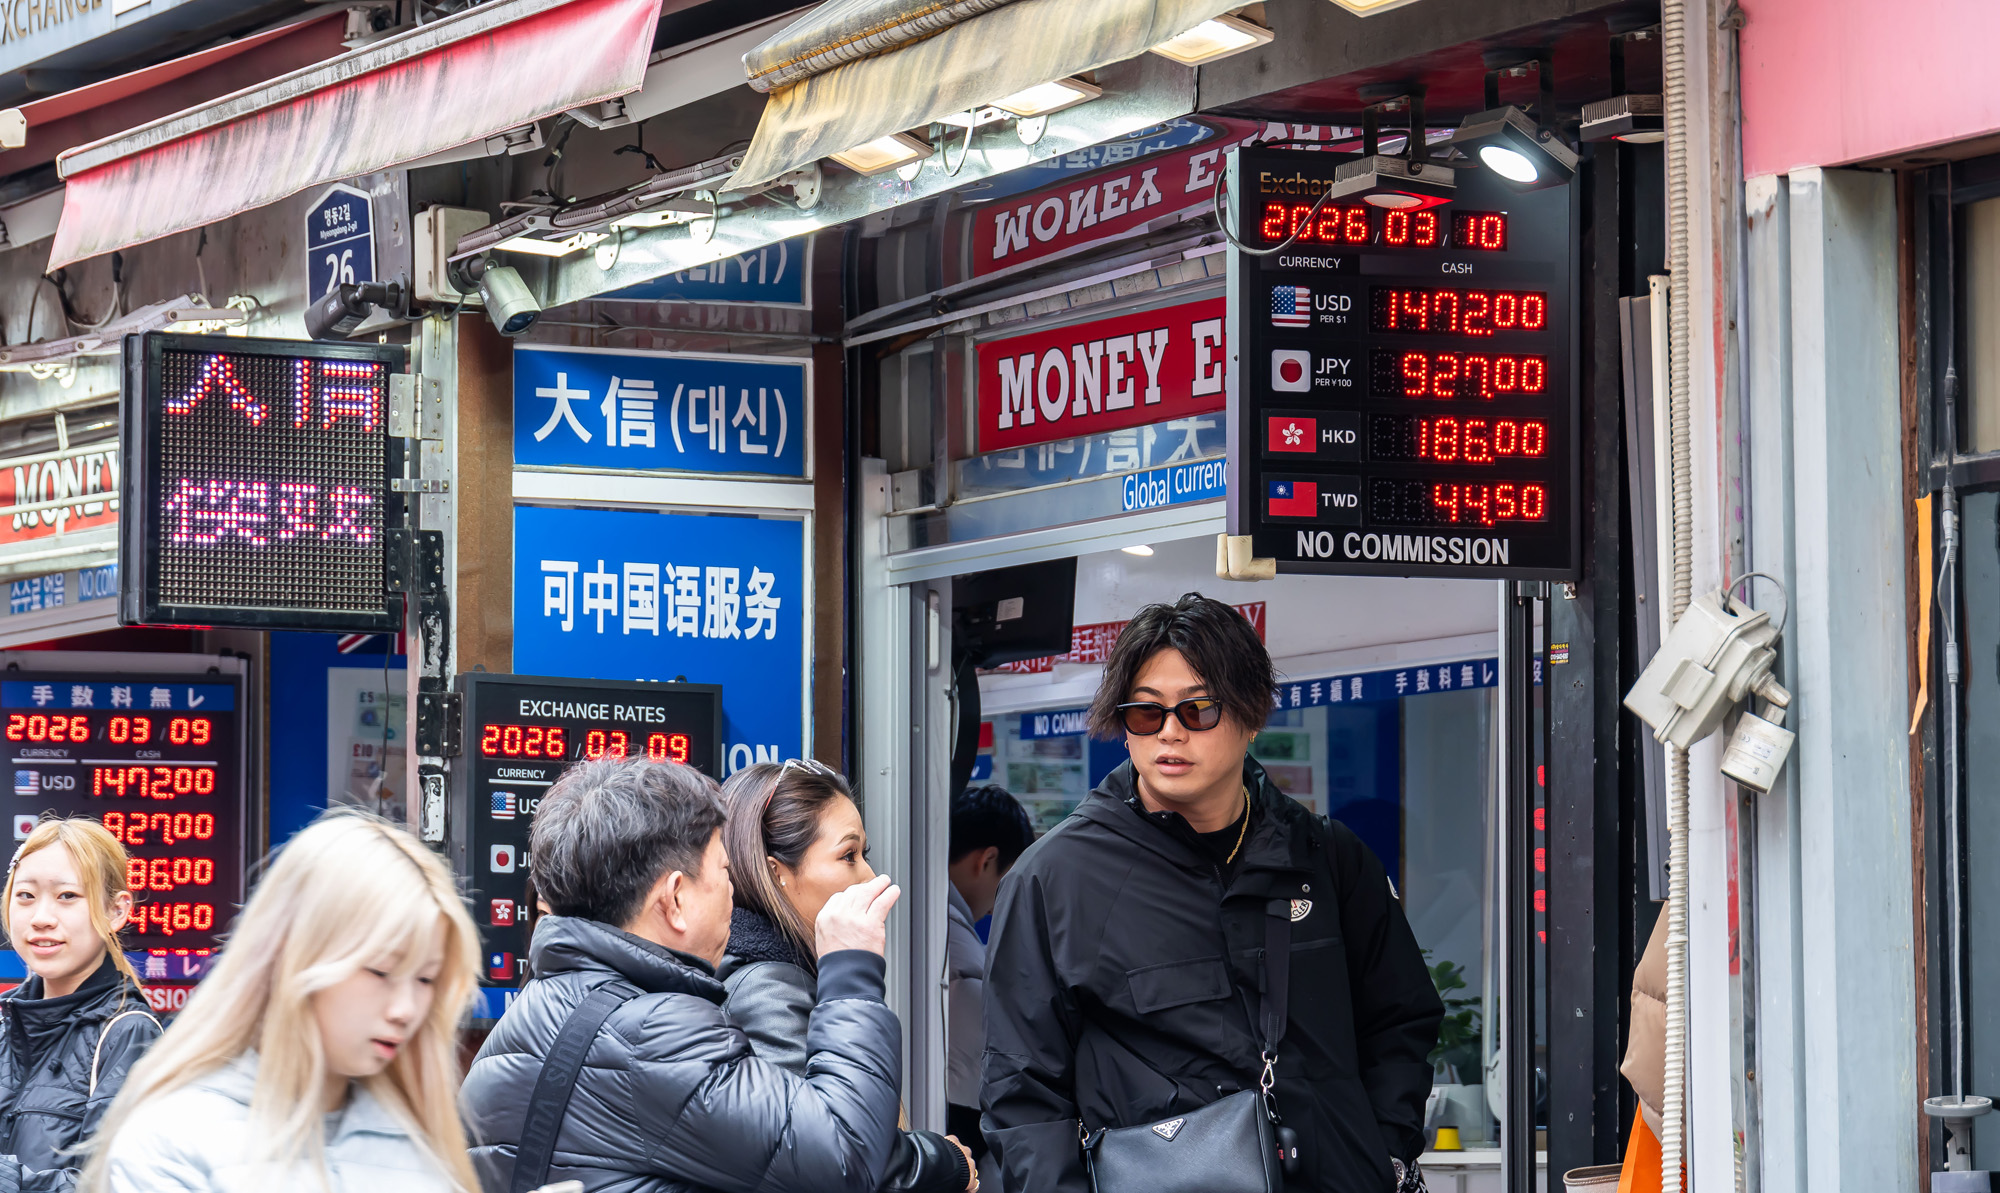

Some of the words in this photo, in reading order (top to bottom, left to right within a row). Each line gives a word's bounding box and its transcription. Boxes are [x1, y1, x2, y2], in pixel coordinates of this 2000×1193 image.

[1, 0, 102, 45] XCHAN
[1259, 171, 1334, 196] Exchan
[323, 203, 351, 227] 명동2길
[325, 248, 355, 295] 26
[1278, 256, 1341, 270] CURRENCY
[1441, 262, 1473, 275] CASH
[1314, 294, 1352, 312] USD
[1319, 314, 1334, 323] PER
[1315, 357, 1352, 375] JPY
[997, 326, 1170, 431] MONEY
[1321, 429, 1356, 444] HKD
[12, 450, 119, 532] MONEY
[1123, 467, 1170, 511] Global
[1321, 493, 1358, 508] TWD
[1296, 530, 1335, 558] NO
[1343, 532, 1509, 565] COMMISSION
[79, 570, 93, 597] NO
[540, 558, 781, 641] 可中国语服务
[519, 699, 609, 720] EXCHANGE
[613, 704, 666, 723] RATES
[1033, 715, 1049, 736] NO
[1052, 710, 1094, 734] COMM
[20, 748, 69, 758] CURRENCY
[135, 750, 161, 760] CASH
[41, 775, 76, 791] USD
[497, 767, 546, 779] CURRENCY
[518, 798, 538, 815] US
[126, 857, 215, 892] 86.00
